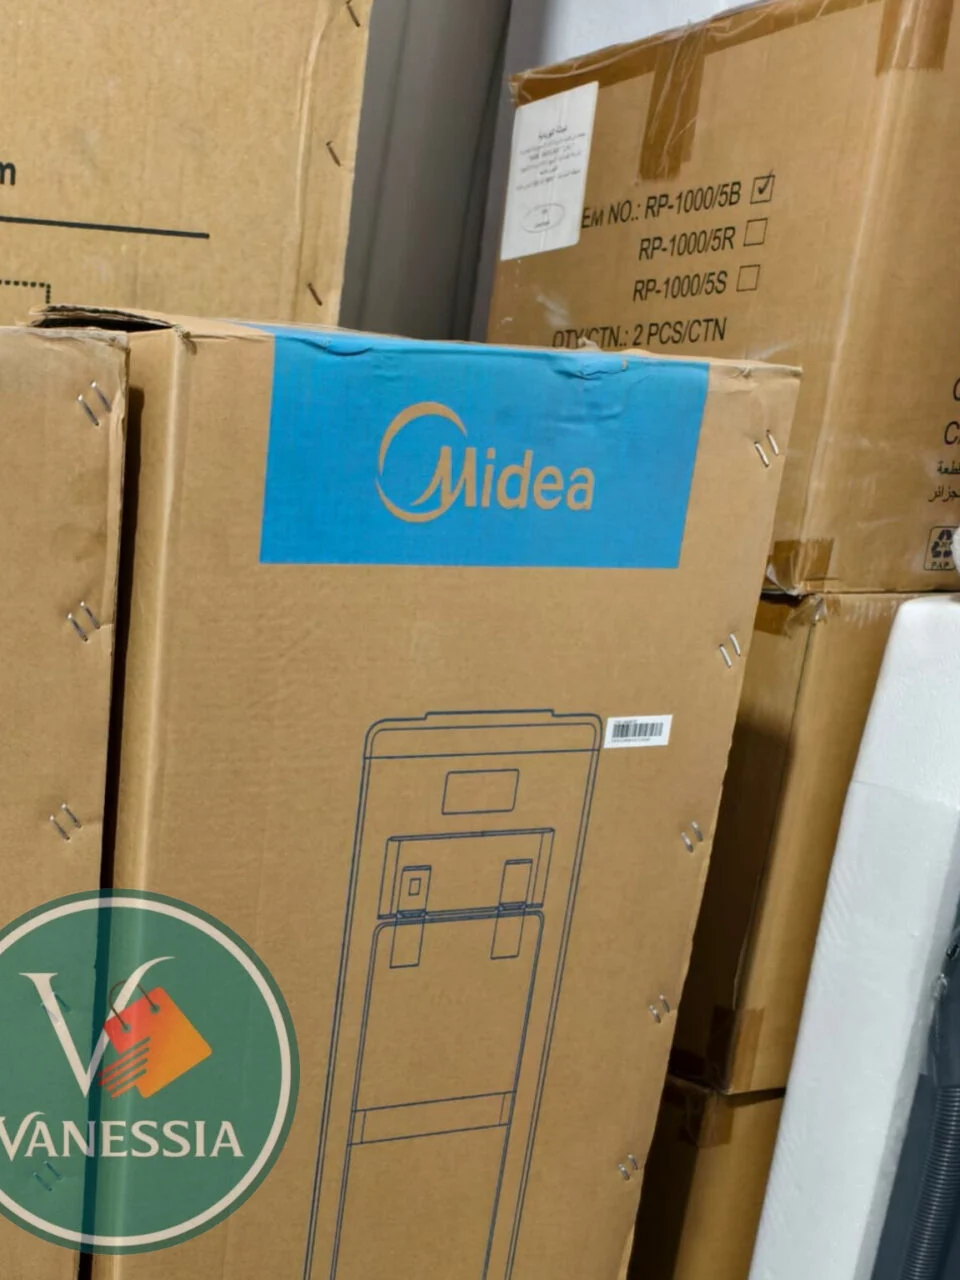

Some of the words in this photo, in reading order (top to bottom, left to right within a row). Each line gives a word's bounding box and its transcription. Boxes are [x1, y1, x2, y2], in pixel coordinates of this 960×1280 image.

[581, 208, 604, 229] EM
[608, 199, 641, 224] NO.:
[644, 181, 742, 219] RP-1000/5B
[638, 226, 736, 261] RP-1000/5R
[633, 270, 728, 302] RP-1000/5S
[633, 323, 643, 347] 2
[646, 317, 727, 346] PCS/CTN
[376, 445, 595, 524] Midea
